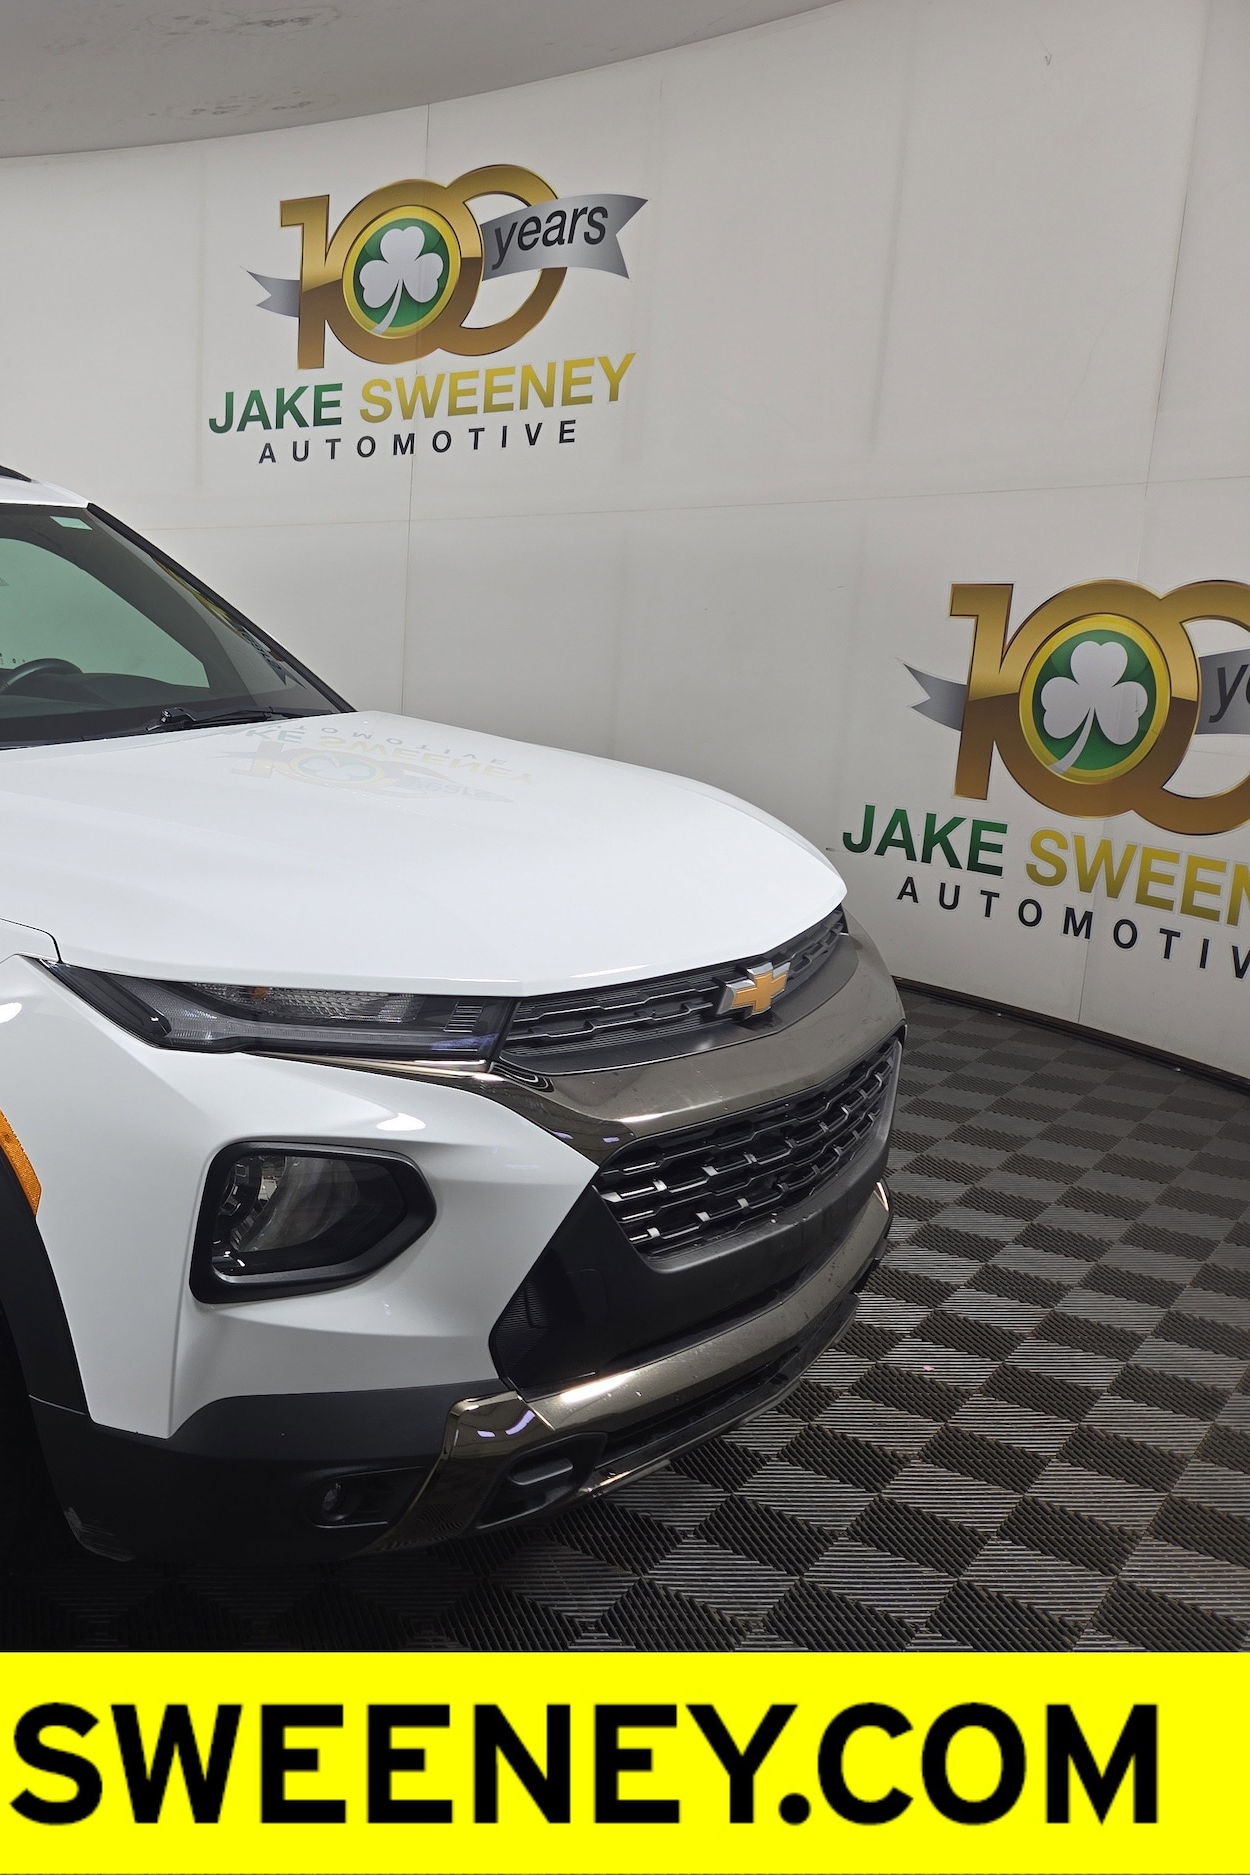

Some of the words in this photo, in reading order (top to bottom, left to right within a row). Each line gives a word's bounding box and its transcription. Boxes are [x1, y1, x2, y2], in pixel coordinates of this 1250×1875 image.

[280, 164, 567, 369] 100
[491, 205, 609, 271] years
[208, 383, 343, 434] JAKE
[360, 352, 637, 424] SWEENEY
[258, 419, 577, 464] AUTOMOTIVE
[842, 804, 1008, 877] JAKE
